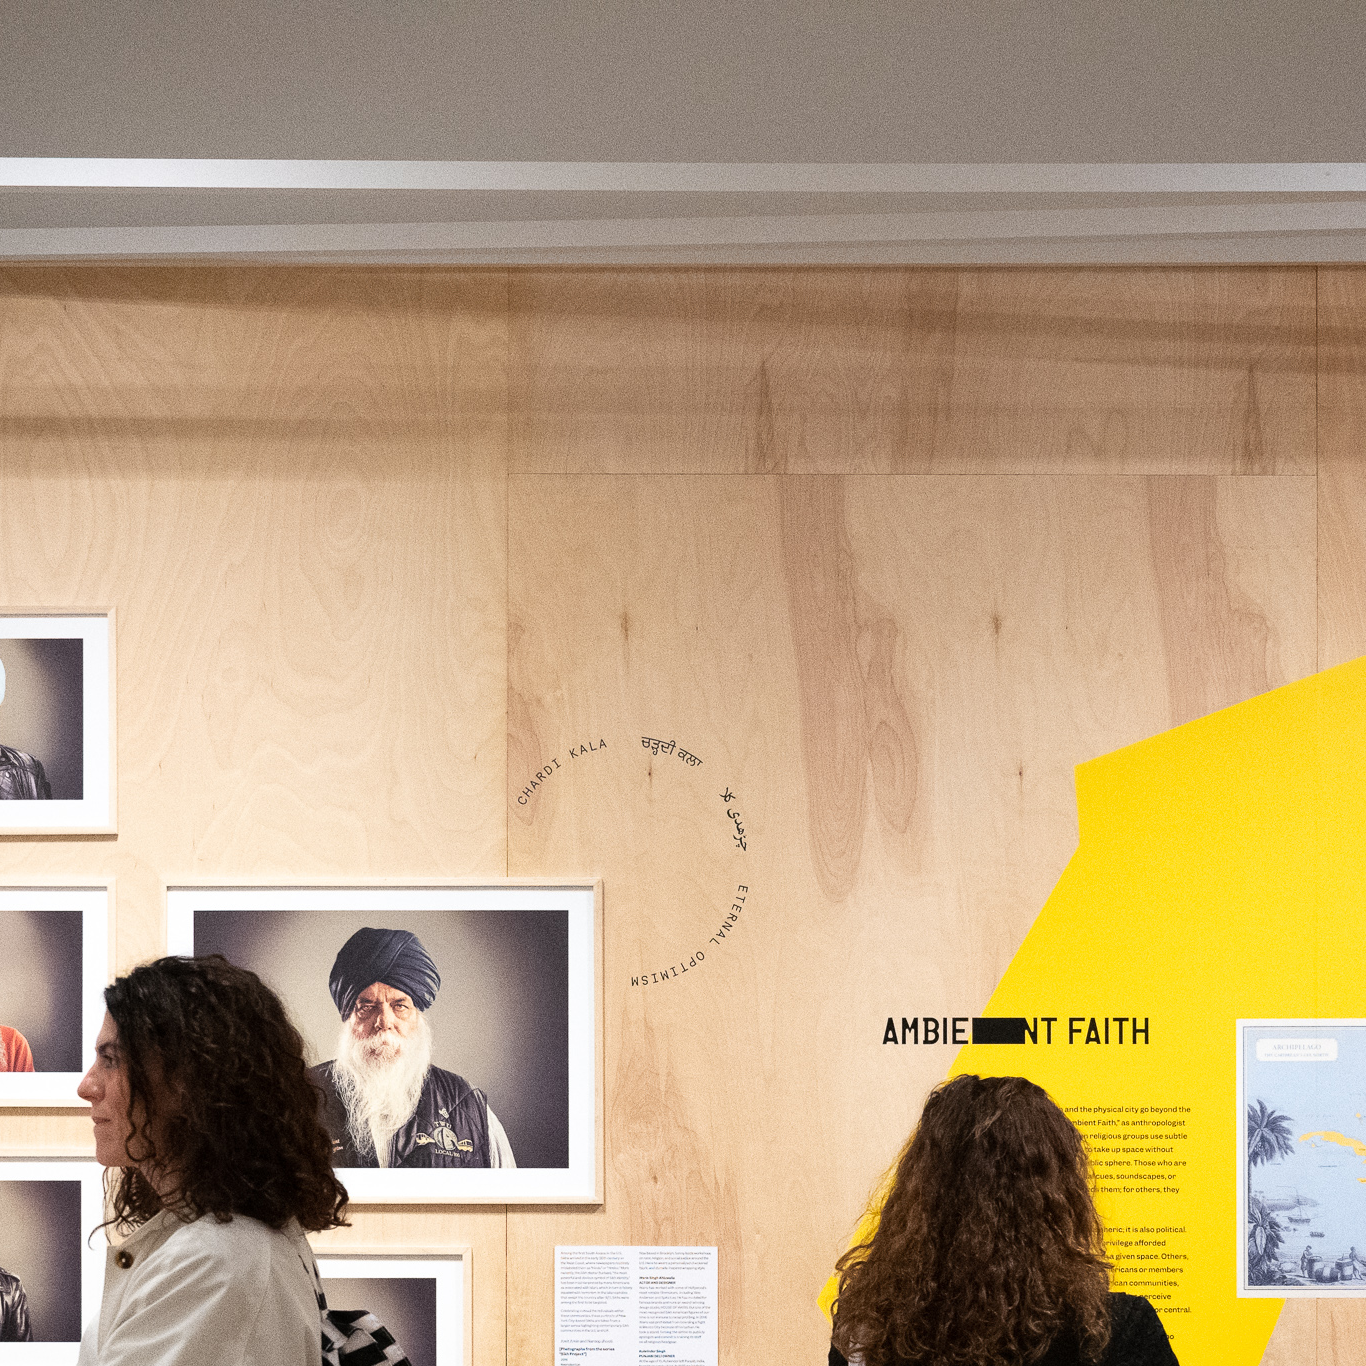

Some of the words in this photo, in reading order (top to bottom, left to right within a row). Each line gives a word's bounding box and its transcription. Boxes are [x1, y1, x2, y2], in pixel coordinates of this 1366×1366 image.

[517, 757, 562, 805] CHARDI
[569, 738, 607, 759] KALA
[709, 884, 749, 945] ETERNAL
[630, 951, 706, 987] OPTIMISM
[1068, 1017, 1150, 1045] FAITH
[1093, 1106, 1124, 1114] physical
[1150, 1106, 1178, 1114] beyond
[1163, 1186, 1180, 1194] they
